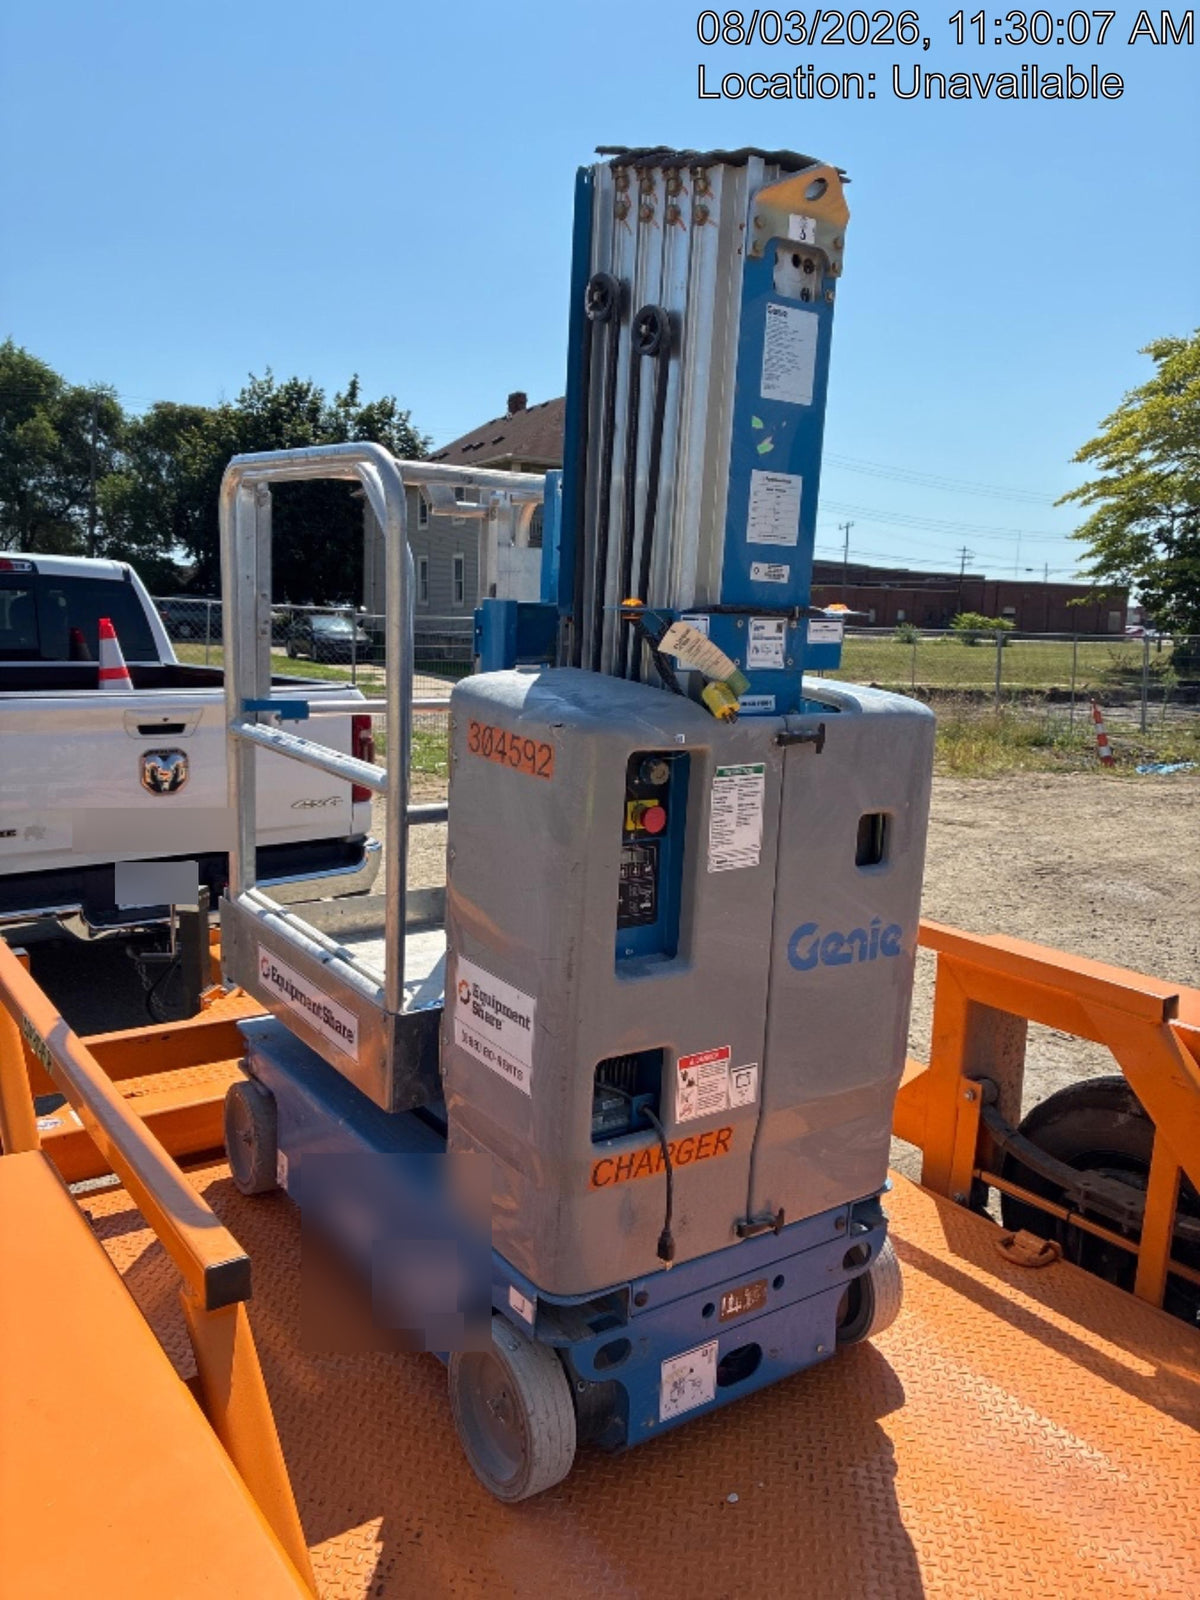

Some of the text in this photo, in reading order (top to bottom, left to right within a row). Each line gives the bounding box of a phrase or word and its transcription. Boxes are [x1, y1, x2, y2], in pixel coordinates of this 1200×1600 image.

[468, 721, 553, 778] 304592
[787, 915, 902, 972] Genie
[271, 965, 355, 1044] EquipmentShare
[472, 1000, 503, 1031] Share
[473, 983, 531, 1031] Equipment
[591, 1126, 734, 1188] CHARGER
